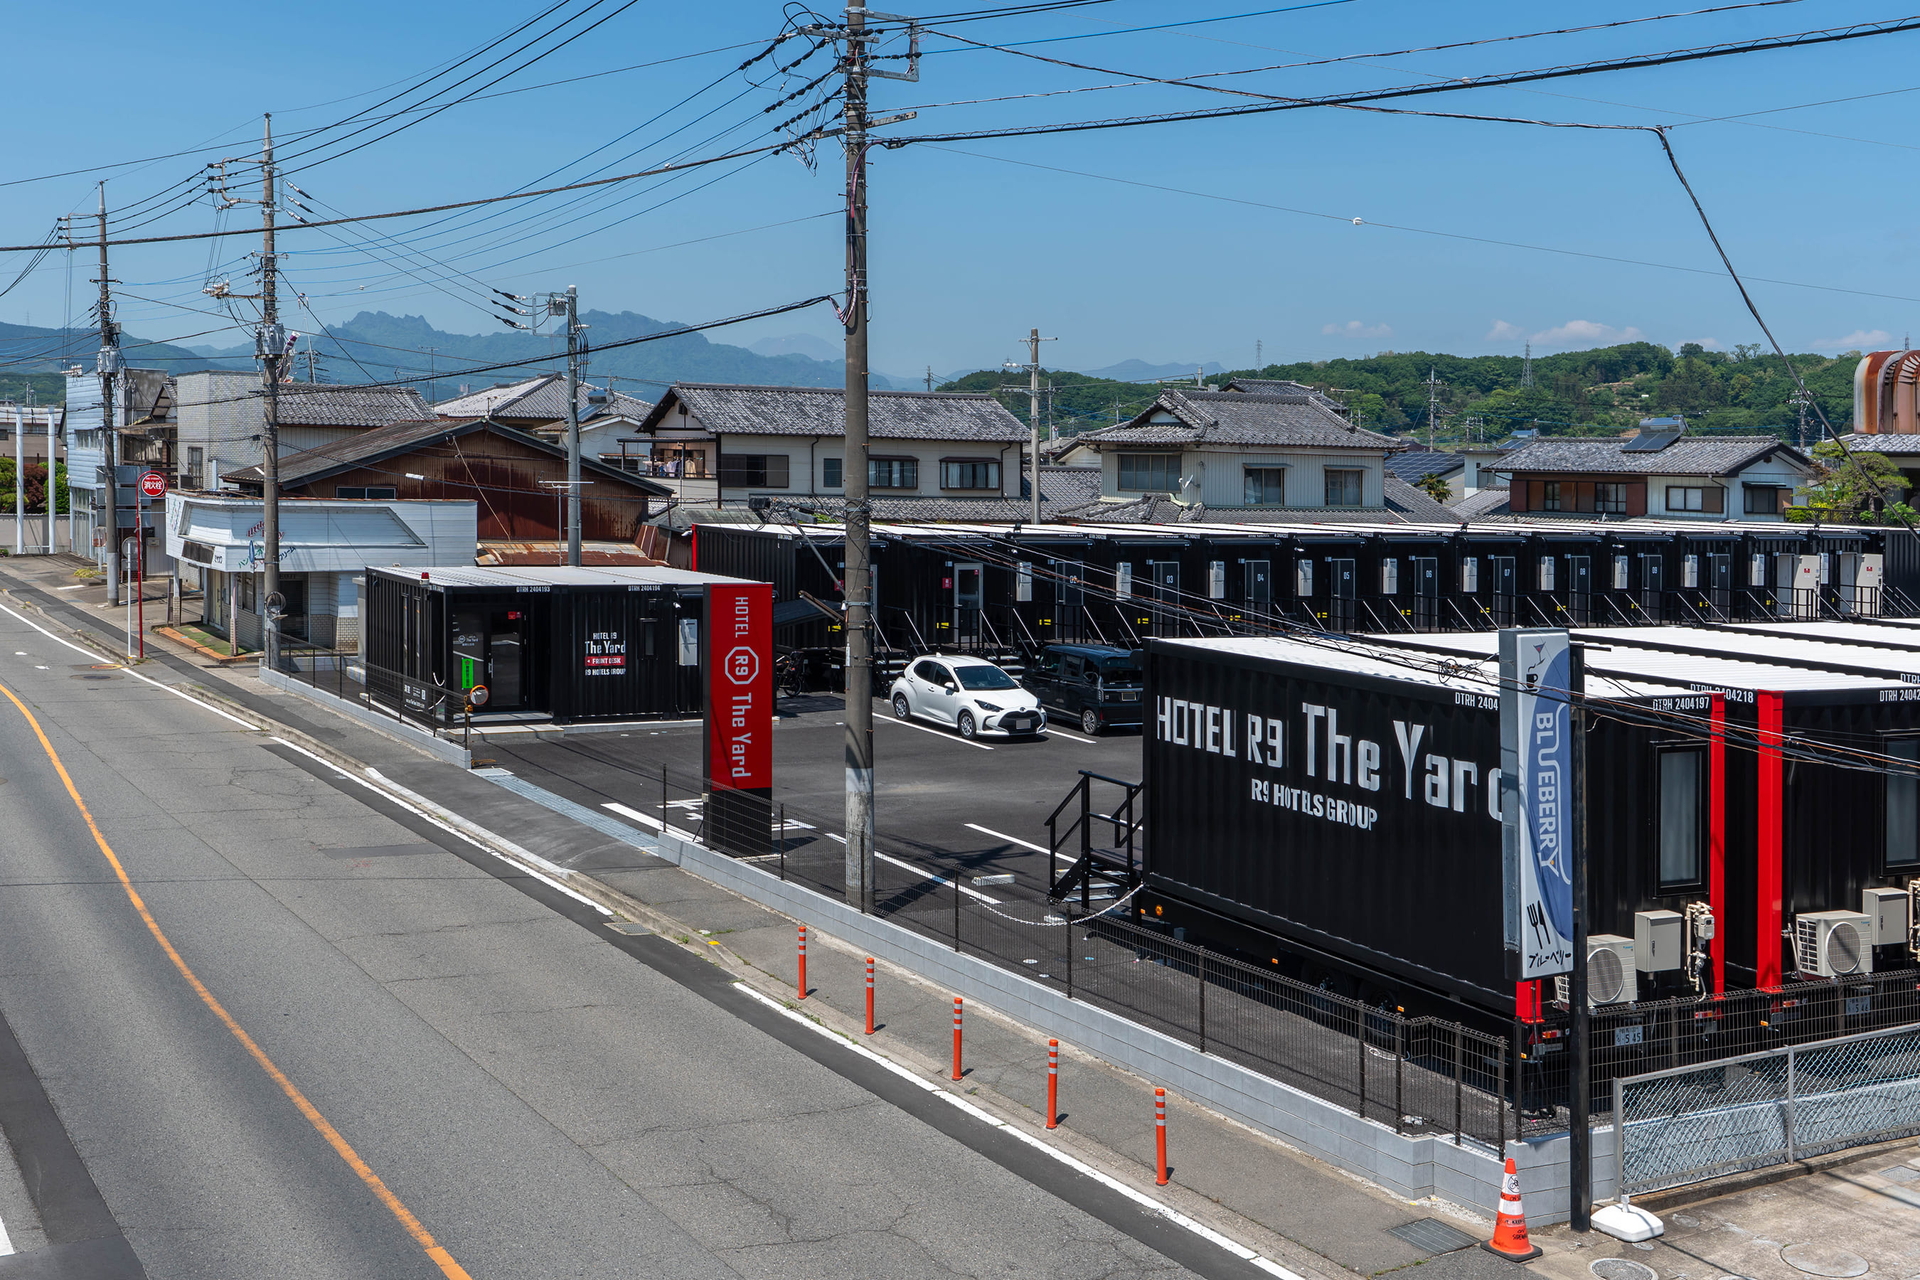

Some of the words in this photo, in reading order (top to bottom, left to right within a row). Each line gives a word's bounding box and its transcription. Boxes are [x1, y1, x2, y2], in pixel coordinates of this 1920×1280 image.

[144, 481, 162, 489] 消火栓
[1166, 575, 1173, 584] 03
[1257, 573, 1264, 582] 04
[1343, 571, 1350, 580] 05
[735, 597, 748, 638] HOTEL
[585, 641, 602, 654] The
[603, 640, 626, 653] Yard
[735, 655, 748, 675] R9
[1455, 692, 1475, 707] DTRH
[1478, 694, 1499, 711] 2404
[1652, 698, 1673, 711] DTRH
[1675, 697, 1710, 710] 2404197
[1880, 690, 1897, 701] DTRH
[1899, 689, 1920, 701] 24042
[732, 692, 752, 727] The
[1157, 695, 1236, 757] HOTEL
[1247, 713, 1283, 768] R9
[1302, 702, 1380, 791] The
[732, 732, 752, 777] Yard
[1535, 706, 1568, 882] BLUEBERRY
[1251, 779, 1269, 803] R9
[1273, 785, 1324, 817] HOTELS
[1326, 797, 1378, 831] GROUP
[1529, 950, 1571, 968] ブルーベリー
